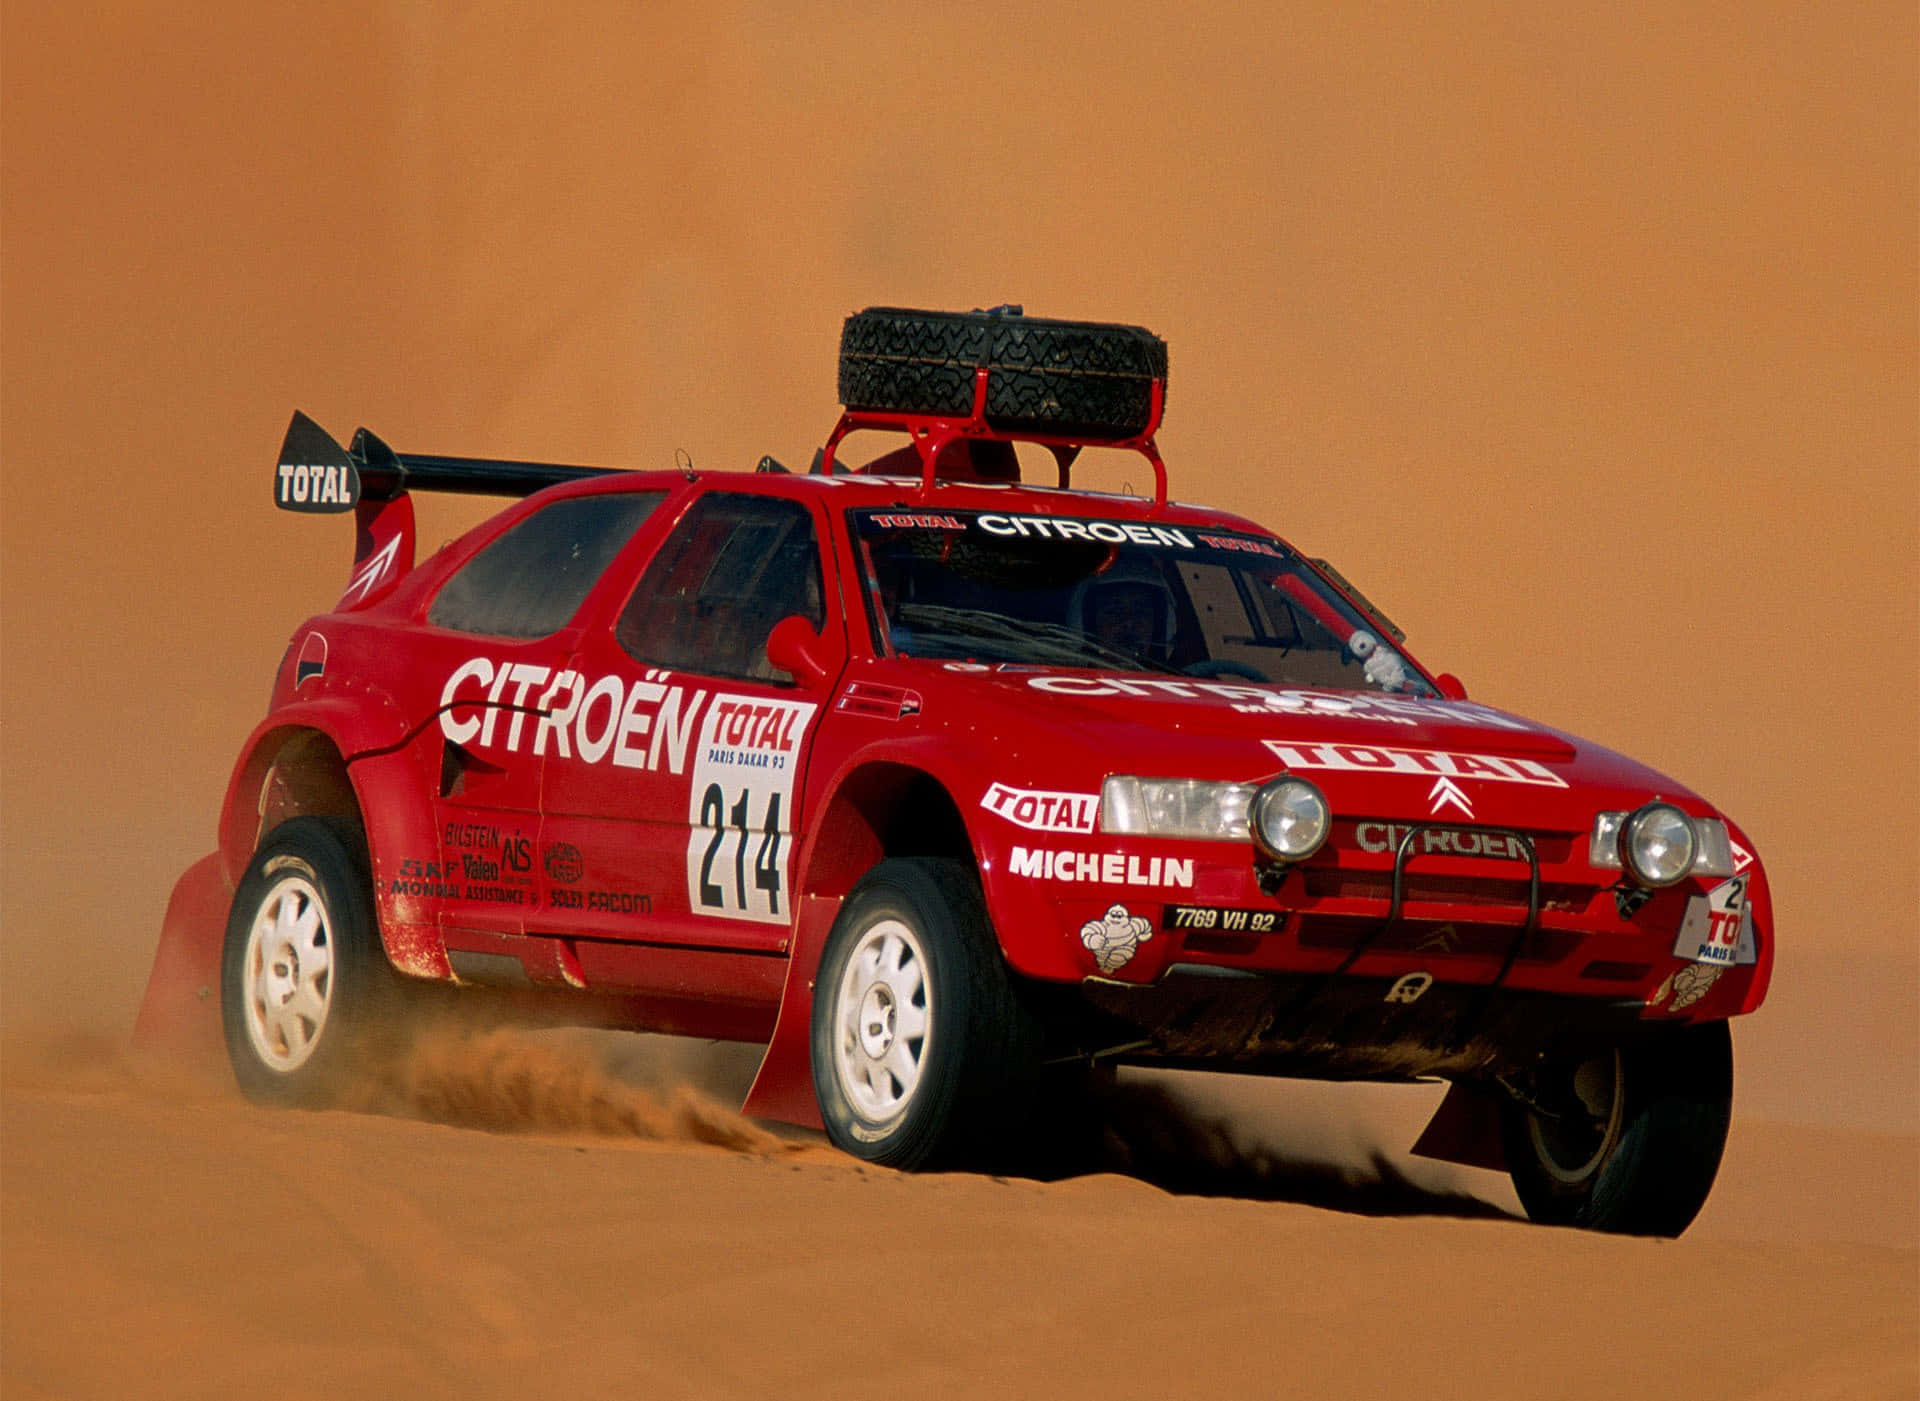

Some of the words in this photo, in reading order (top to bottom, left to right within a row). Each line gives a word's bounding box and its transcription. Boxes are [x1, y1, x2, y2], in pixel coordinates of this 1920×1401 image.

[279, 465, 351, 504] TOTAL
[870, 514, 967, 530] TOTAL
[976, 515, 1194, 549] CITROEN
[1198, 534, 1284, 558] TOTAL
[439, 657, 706, 775] CITROËN
[713, 702, 800, 752] TOTAL
[708, 749, 735, 764] PARIS
[738, 752, 769, 768] DAKAR
[772, 756, 785, 769] 93
[1283, 742, 1562, 784] TOTAL
[992, 786, 1091, 830] TOTAL
[444, 823, 500, 850] BILSTEIN
[700, 783, 782, 914] 214
[400, 859, 459, 878] SKF
[1008, 846, 1195, 888] MICHELIN
[466, 886, 524, 905] ASSISTANCE
[551, 889, 584, 909] SOLEX
[1175, 907, 1218, 928] 7769
[1223, 910, 1249, 930] VH
[1250, 913, 1276, 932] 92
[1698, 944, 1728, 960] PARIS
